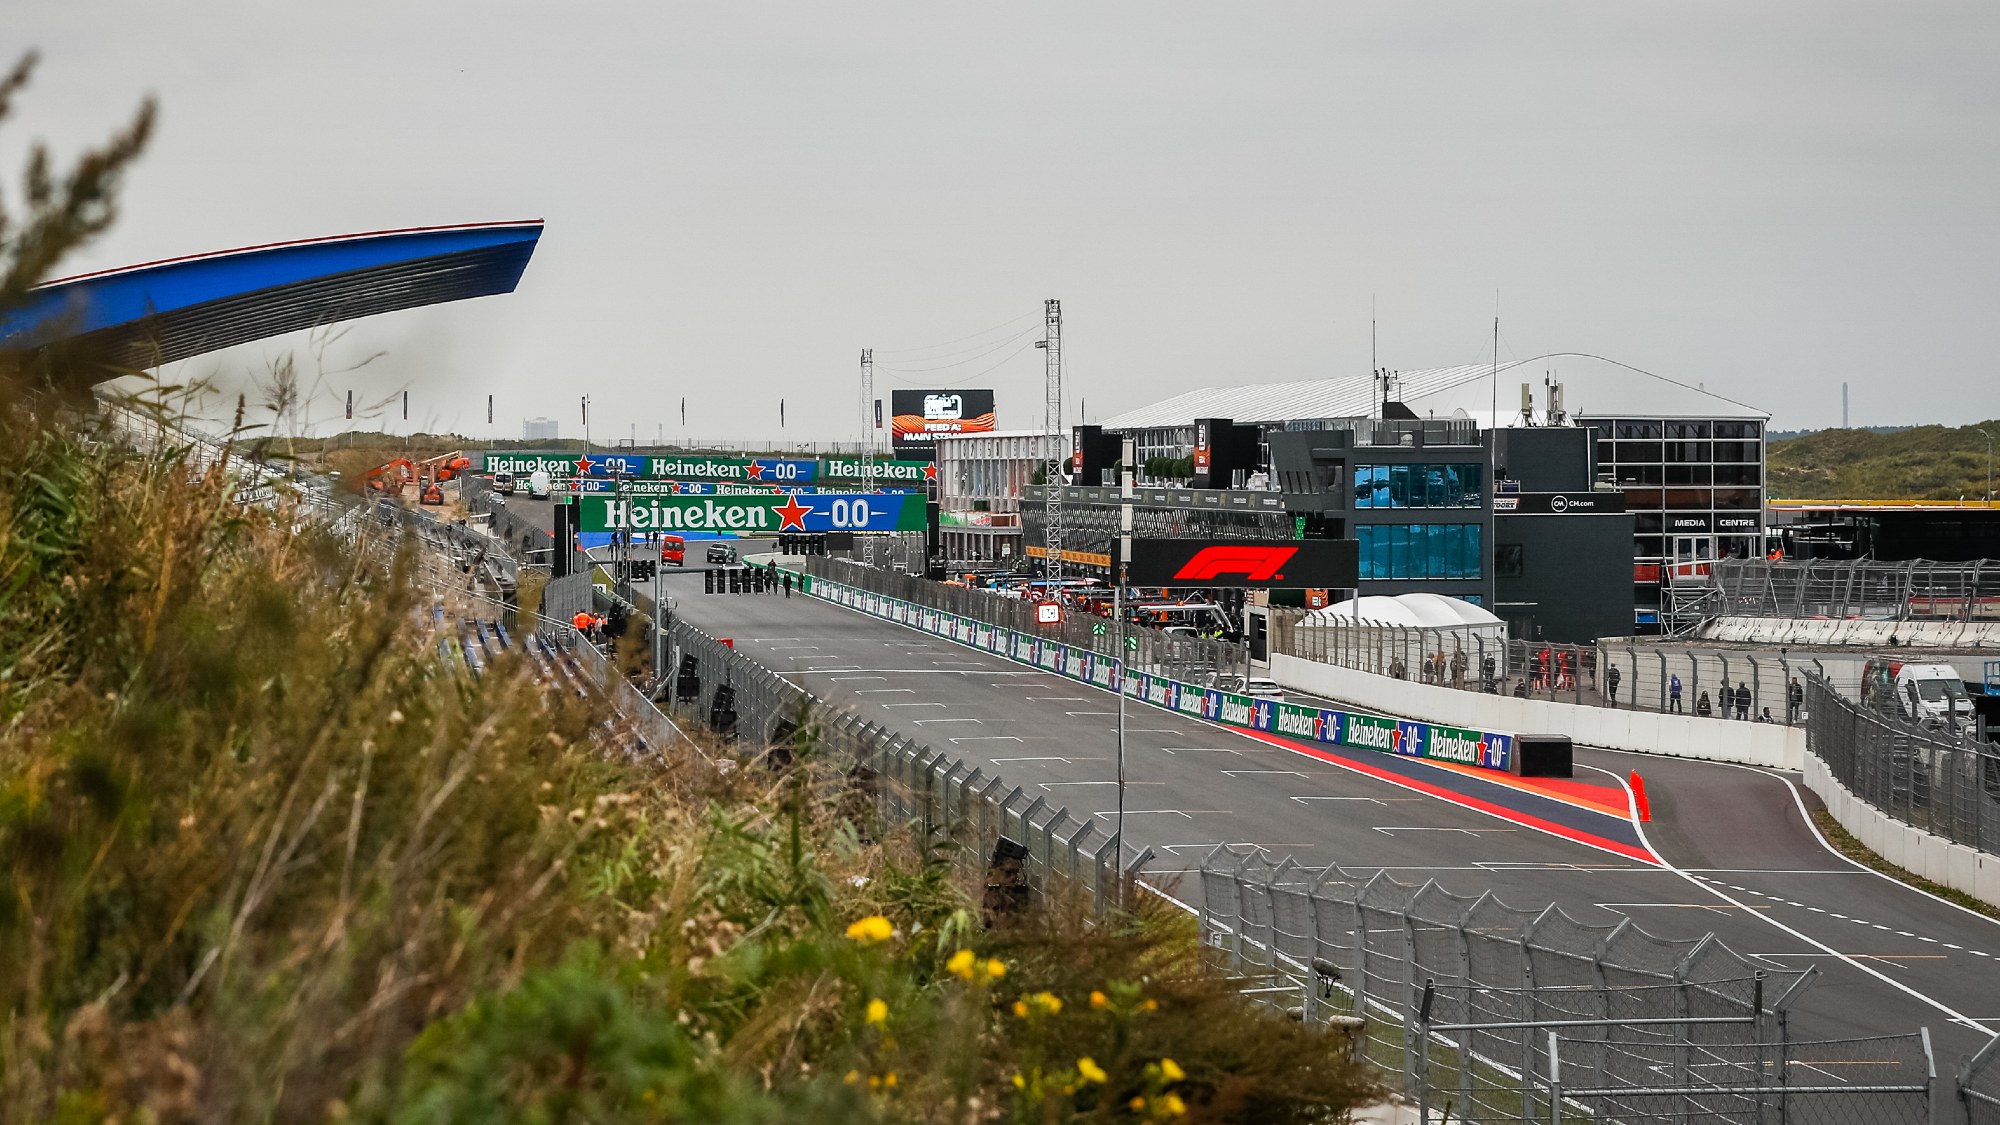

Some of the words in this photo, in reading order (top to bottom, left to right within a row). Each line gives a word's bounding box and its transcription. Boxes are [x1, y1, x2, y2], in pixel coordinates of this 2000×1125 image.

[904, 433, 931, 441] MAIN
[924, 423, 951, 432] FEED
[486, 456, 570, 473] Heineken
[605, 457, 627, 474] 00
[652, 458, 741, 478] Heineken
[775, 463, 797, 480] 0.0
[828, 460, 918, 479] Heineken
[716, 484, 770, 495] Heineken
[603, 499, 768, 528] Heineken
[830, 498, 870, 528] 0.0
[1674, 519, 1706, 527] MEDIA
[1719, 519, 1755, 527] CENTRE
[1221, 695, 1249, 725] Heineken
[1277, 705, 1314, 736] Heineken
[1347, 716, 1391, 749] Heineken
[1429, 728, 1476, 762] Heineken
